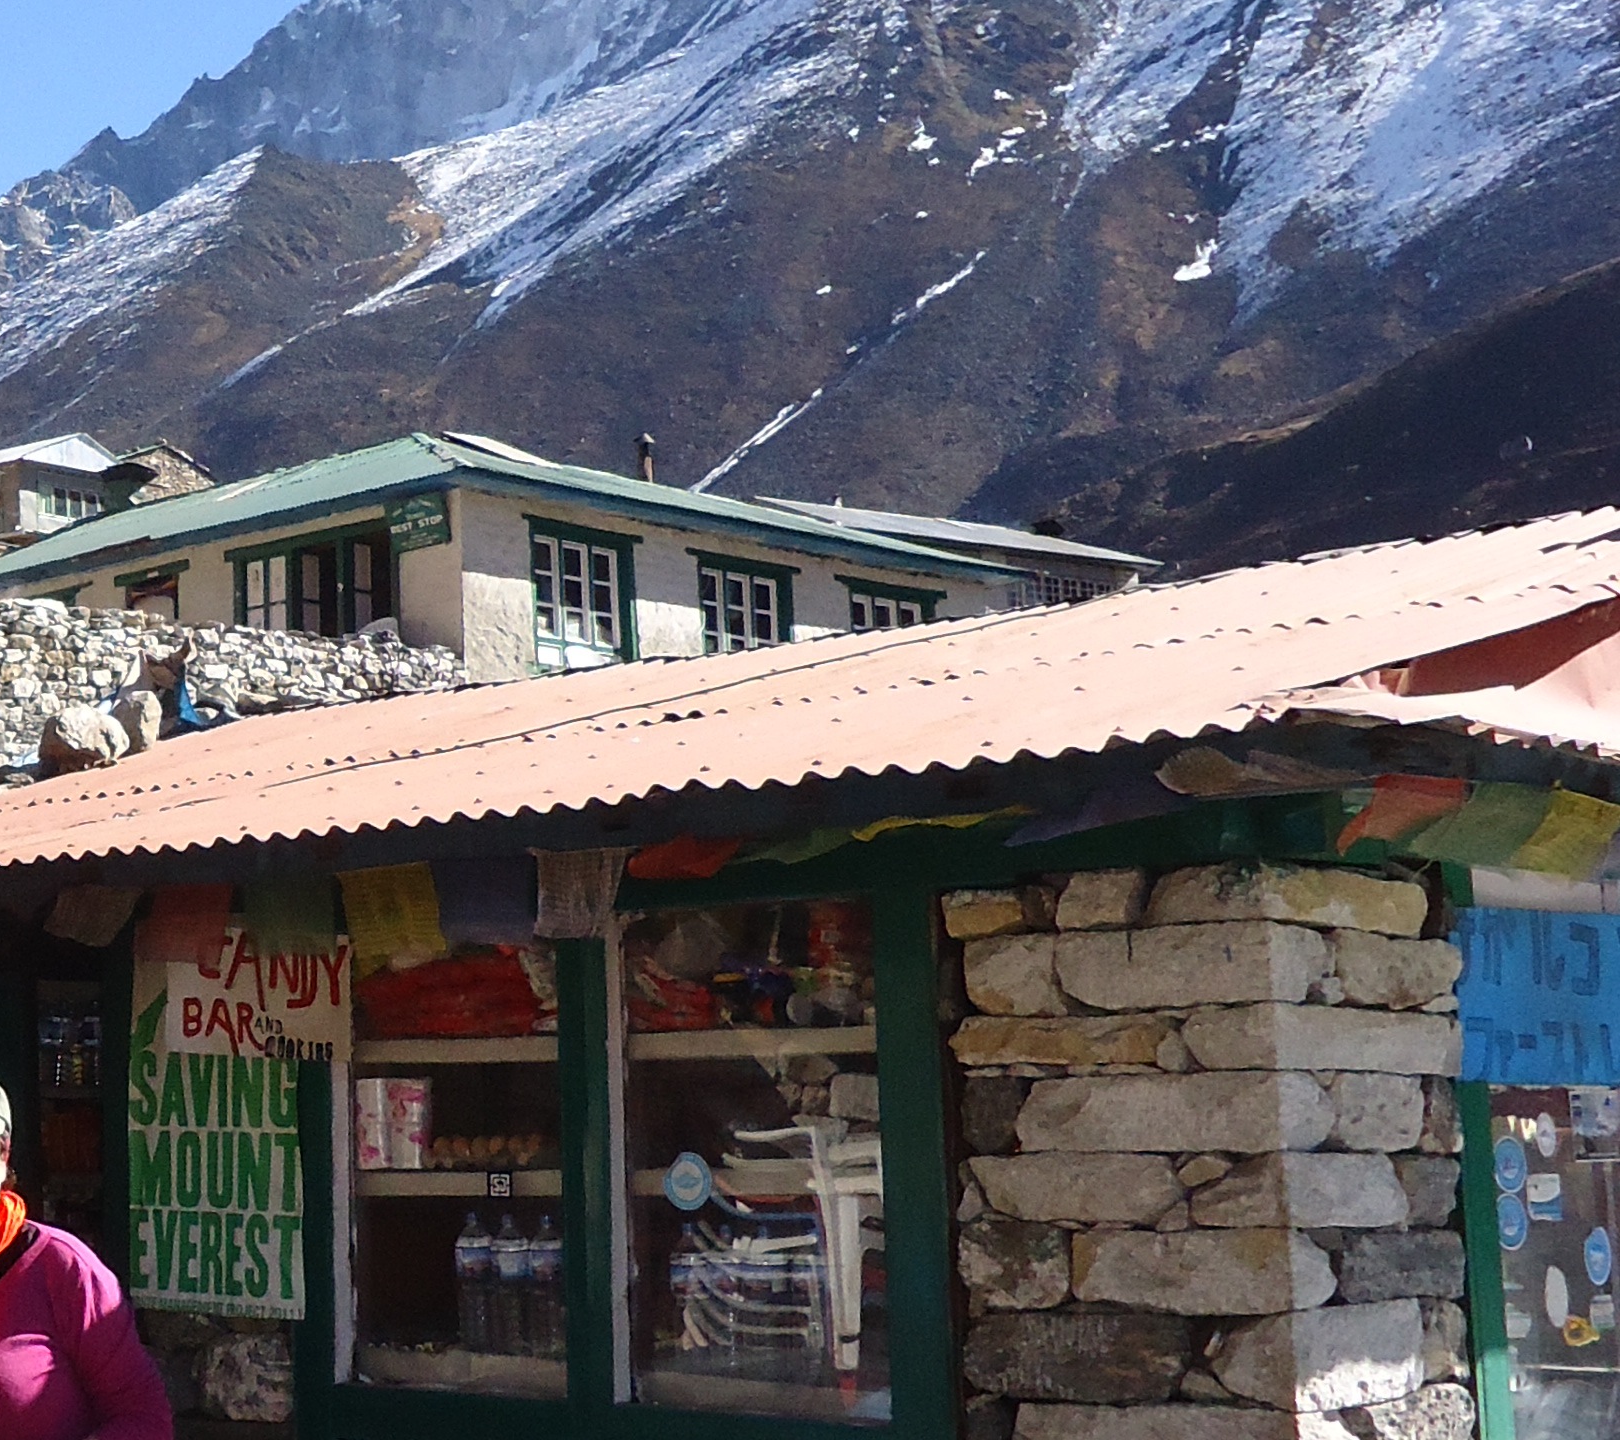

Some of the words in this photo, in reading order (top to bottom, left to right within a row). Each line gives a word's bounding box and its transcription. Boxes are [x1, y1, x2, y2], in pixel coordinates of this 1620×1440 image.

[418, 515, 443, 528] STOP
[182, 997, 264, 1055] BAR
[254, 1015, 283, 1035] AND
[129, 1049, 299, 1128] SAVING
[129, 1129, 300, 1213] MOUNT
[129, 1209, 301, 1299] EVEREST
